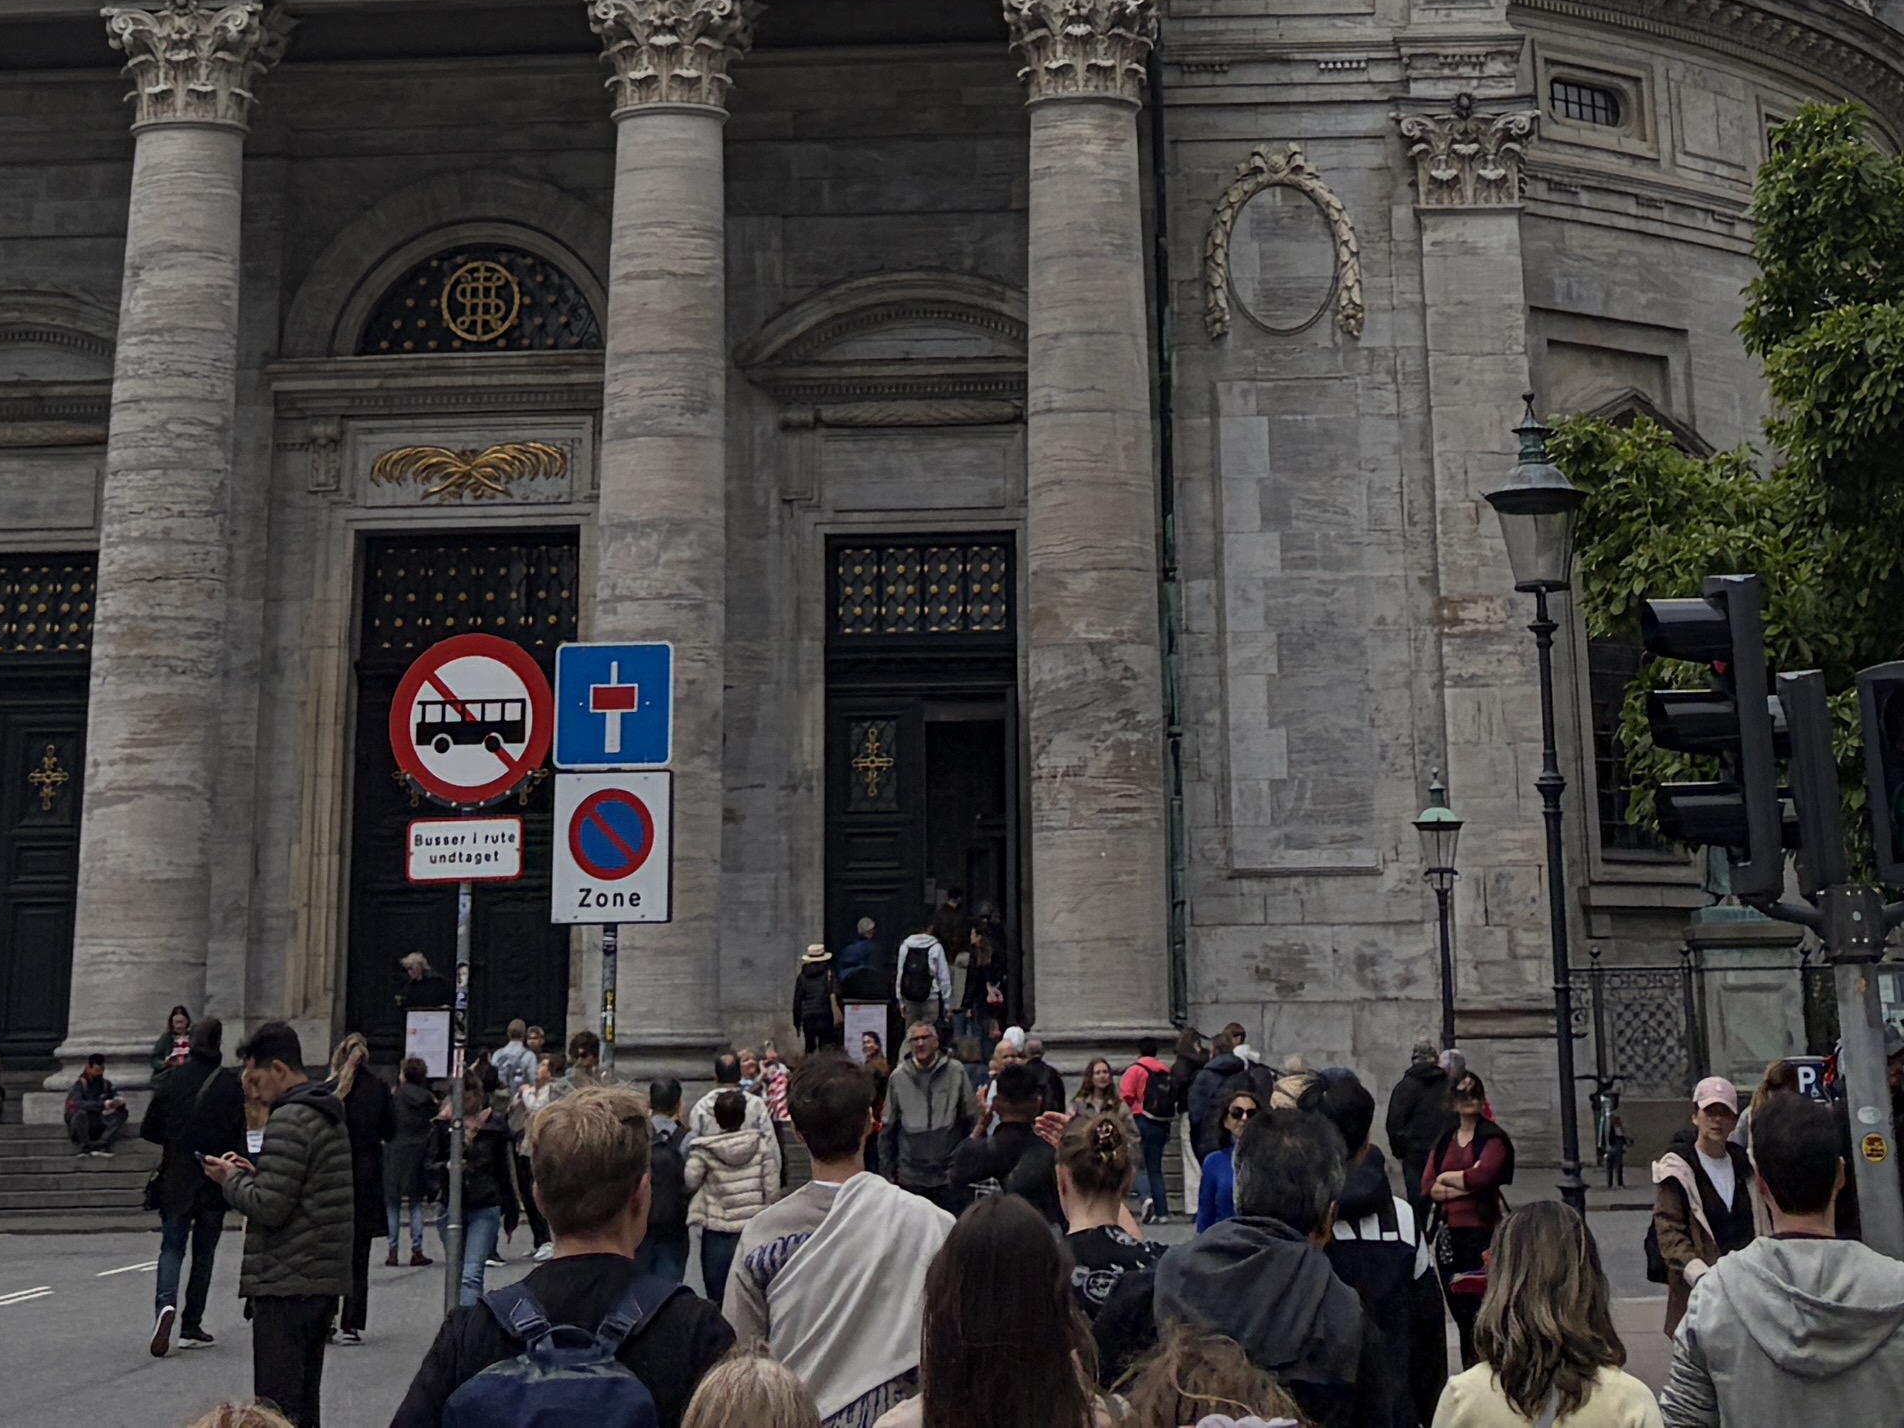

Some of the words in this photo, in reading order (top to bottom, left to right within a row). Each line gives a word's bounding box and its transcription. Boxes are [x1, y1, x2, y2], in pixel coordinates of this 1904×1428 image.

[414, 833, 466, 847] Busser
[484, 831, 516, 845] rute
[429, 850, 499, 865] undtaget
[578, 887, 641, 908] Zone
[1798, 1066, 1816, 1094] P
